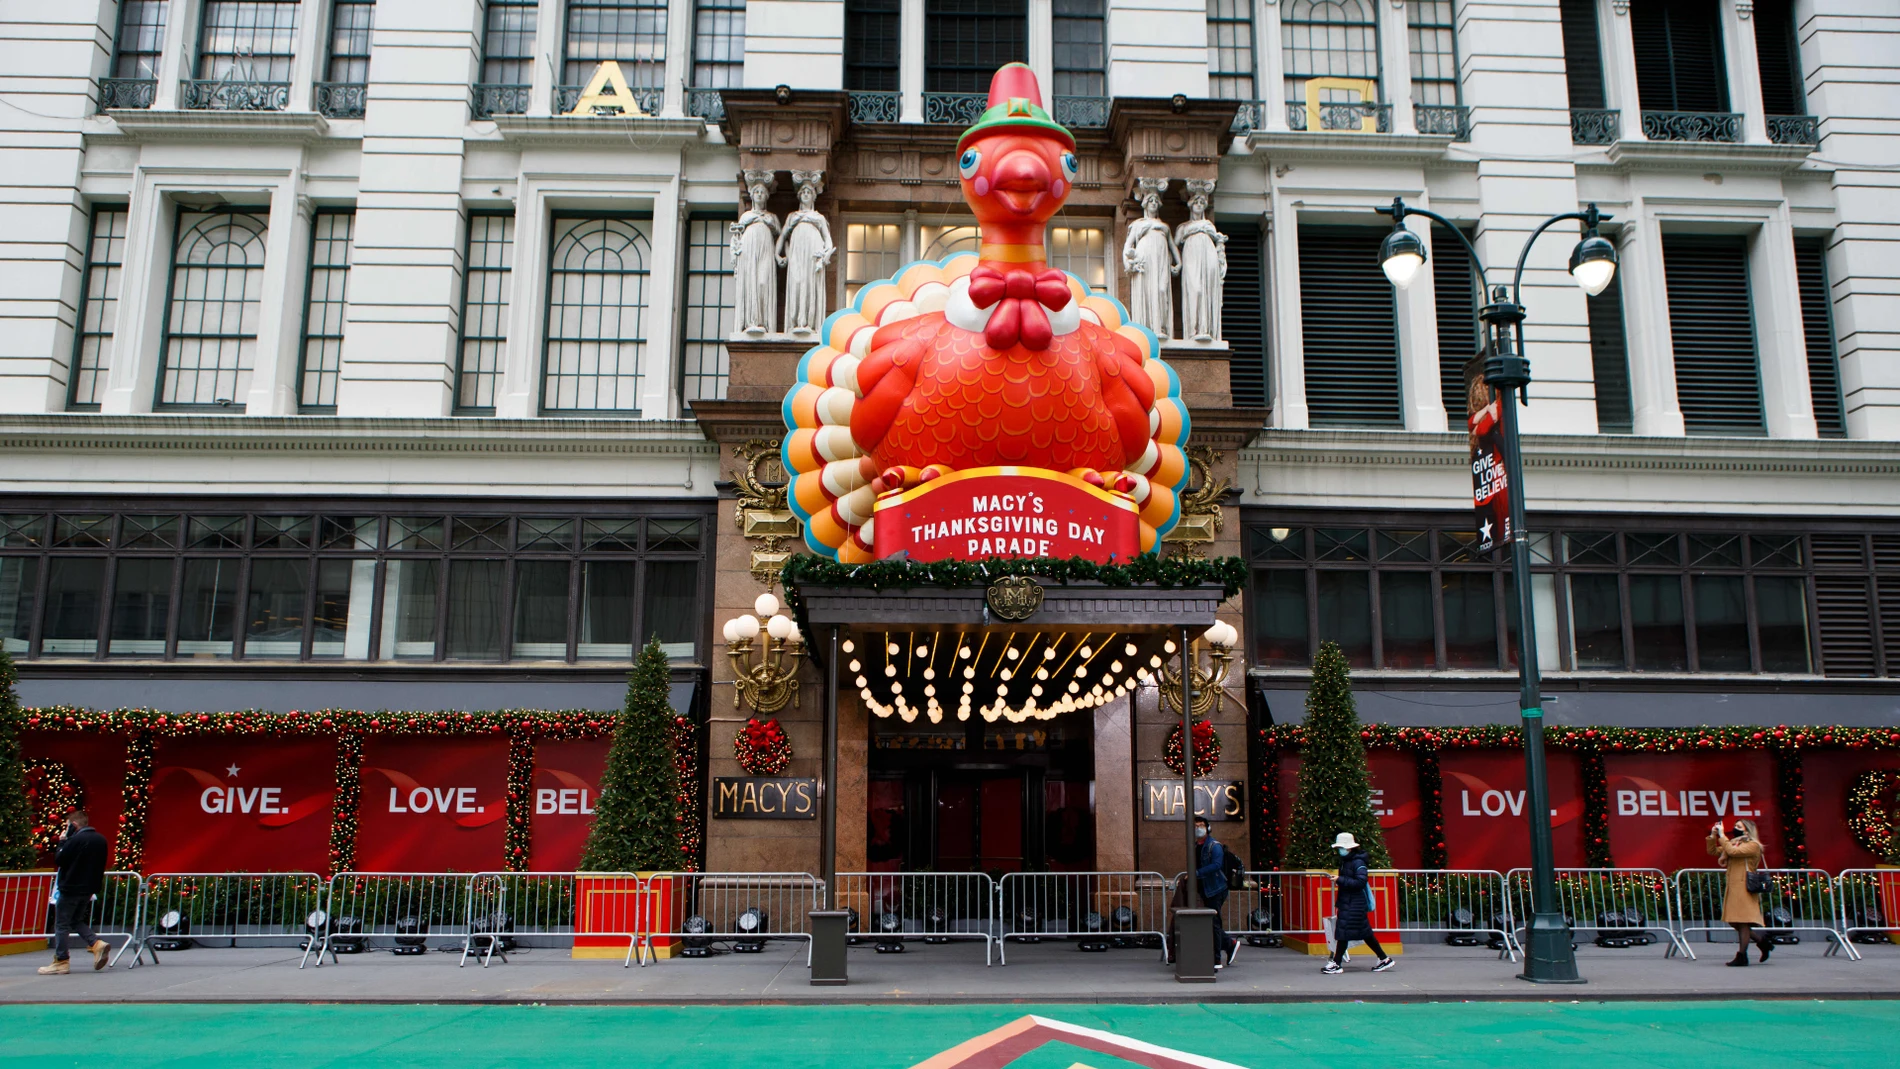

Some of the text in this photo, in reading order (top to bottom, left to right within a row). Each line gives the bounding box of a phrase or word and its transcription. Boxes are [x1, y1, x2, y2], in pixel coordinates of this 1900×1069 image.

[570, 60, 641, 115] A
[1472, 453, 1496, 475] GIVE.
[972, 491, 1044, 514] MACY'S
[911, 516, 1105, 545] THANKSGIVING DAY
[967, 538, 1050, 557] PARADE
[200, 786, 289, 814] GIVE.
[389, 786, 485, 814] LOVE.
[719, 782, 812, 813] MACY'S
[1461, 789, 1558, 817] LOV.
[1616, 789, 1762, 817] BELIEVE.
